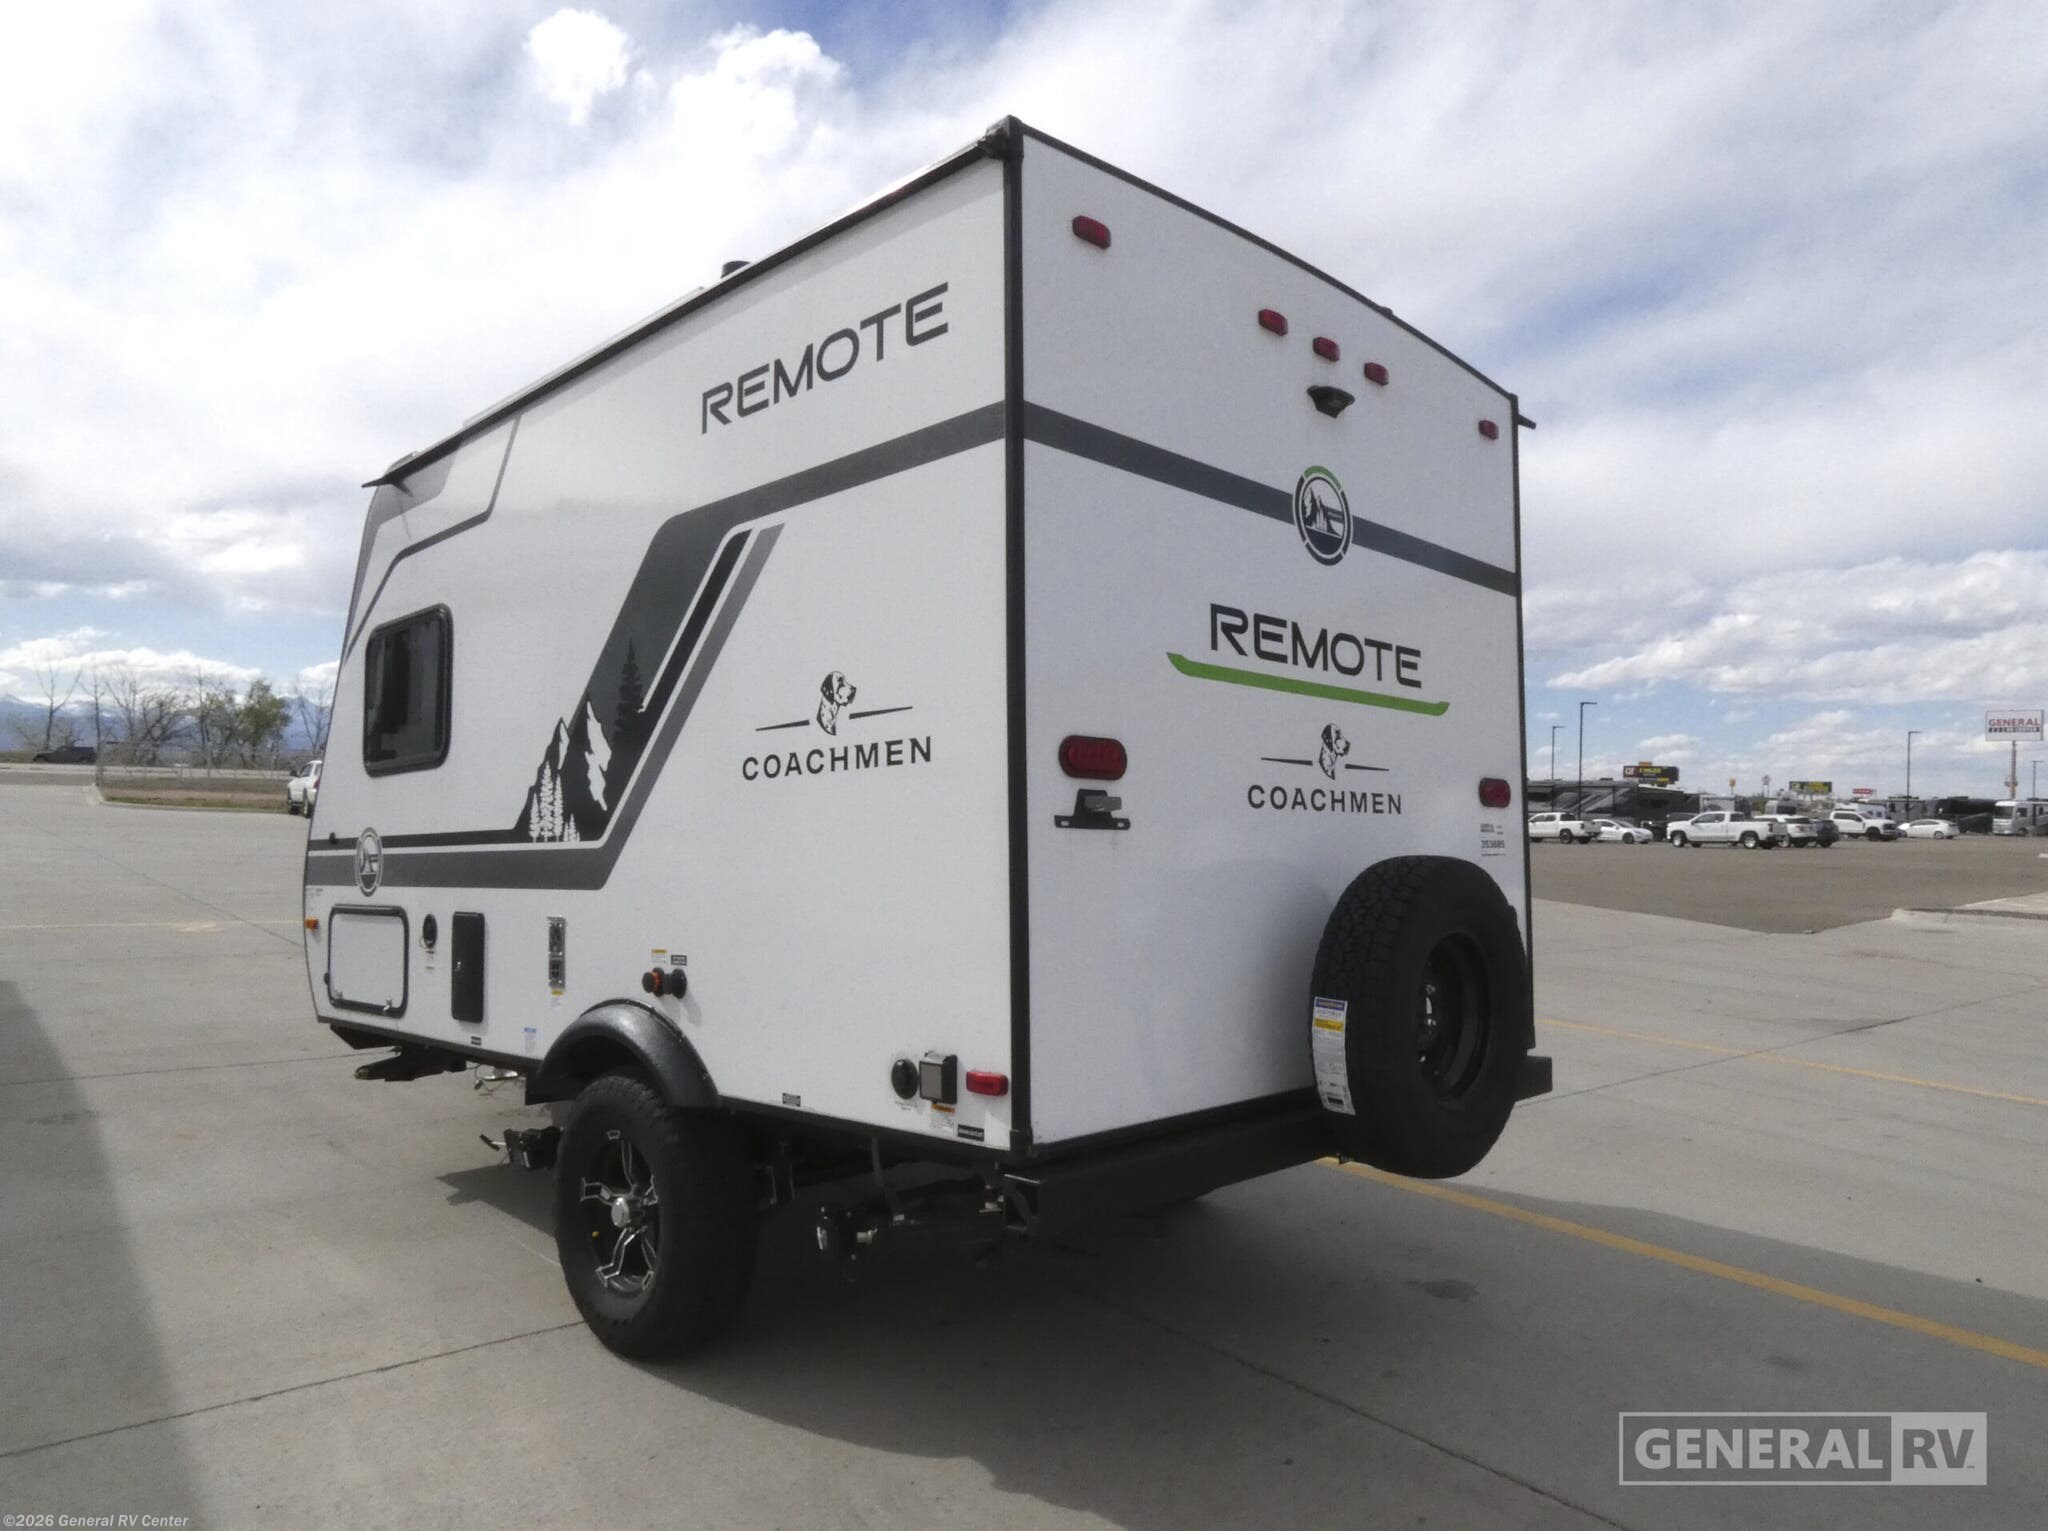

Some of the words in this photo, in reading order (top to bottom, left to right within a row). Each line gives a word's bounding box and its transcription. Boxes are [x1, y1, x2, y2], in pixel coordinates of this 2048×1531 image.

[701, 281, 949, 435] REMOTE
[1209, 602, 1423, 689] REMOTE
[1988, 718, 2041, 727] GENERAL
[742, 735, 932, 781] COACHMEN
[1246, 784, 1402, 815] COACHMEN
